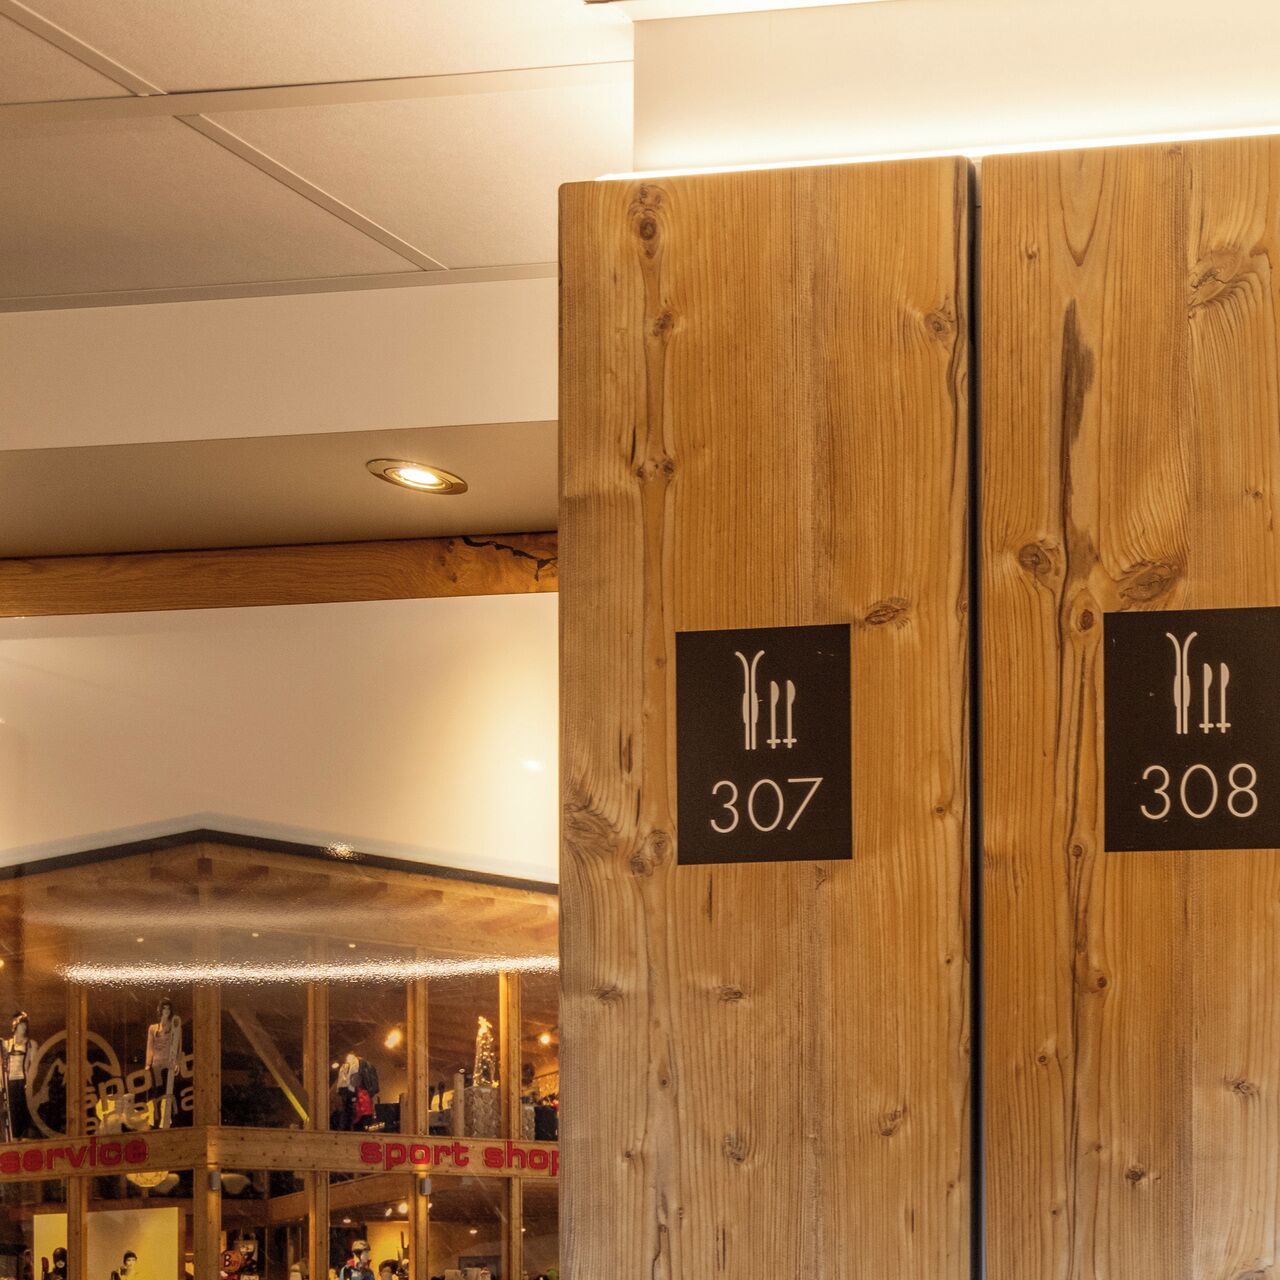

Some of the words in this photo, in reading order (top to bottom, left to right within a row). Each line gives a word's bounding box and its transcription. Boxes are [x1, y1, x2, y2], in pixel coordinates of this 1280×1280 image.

[710, 777, 824, 834] 307
[1140, 762, 1258, 820] 308
[0, 1137, 148, 1173] service
[360, 1141, 470, 1171] sport
